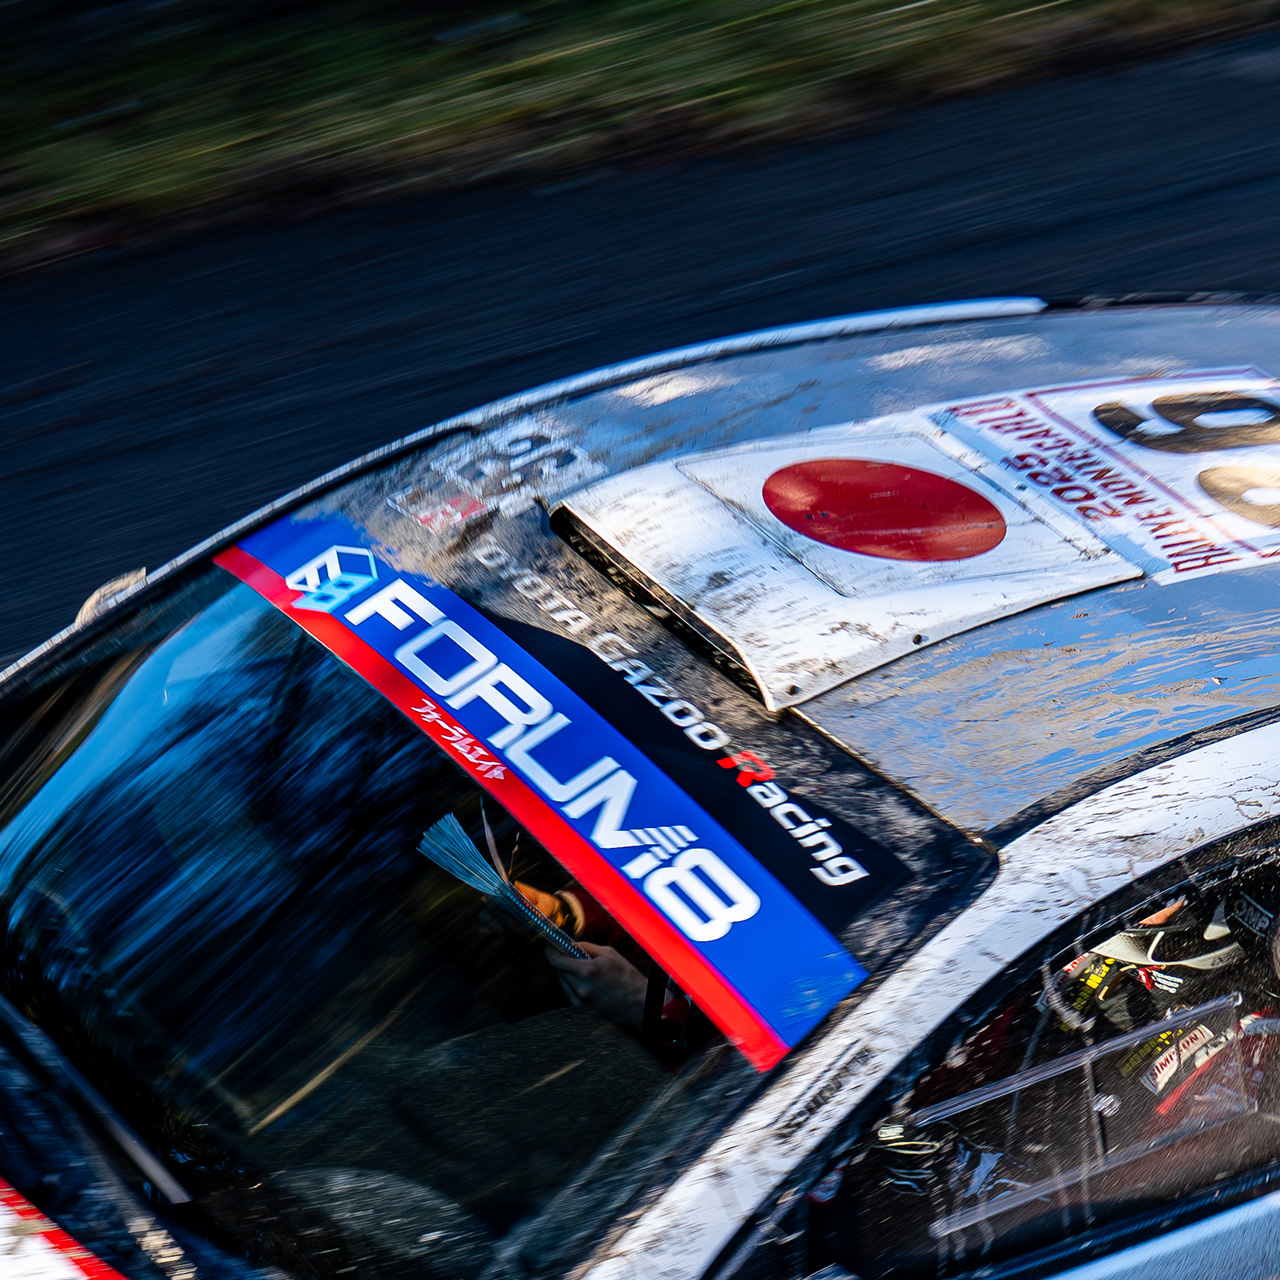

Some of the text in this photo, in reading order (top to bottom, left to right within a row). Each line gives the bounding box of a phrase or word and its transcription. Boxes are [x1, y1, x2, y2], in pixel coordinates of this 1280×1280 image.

[994, 450, 1124, 522] 2025
[1130, 508, 1242, 573] RALLYE
[344, 577, 762, 944] FORUM8
[586, 632, 730, 753] GAZOO
[716, 750, 871, 886] Racing
[1150, 1030, 1202, 1083] SIMPON
